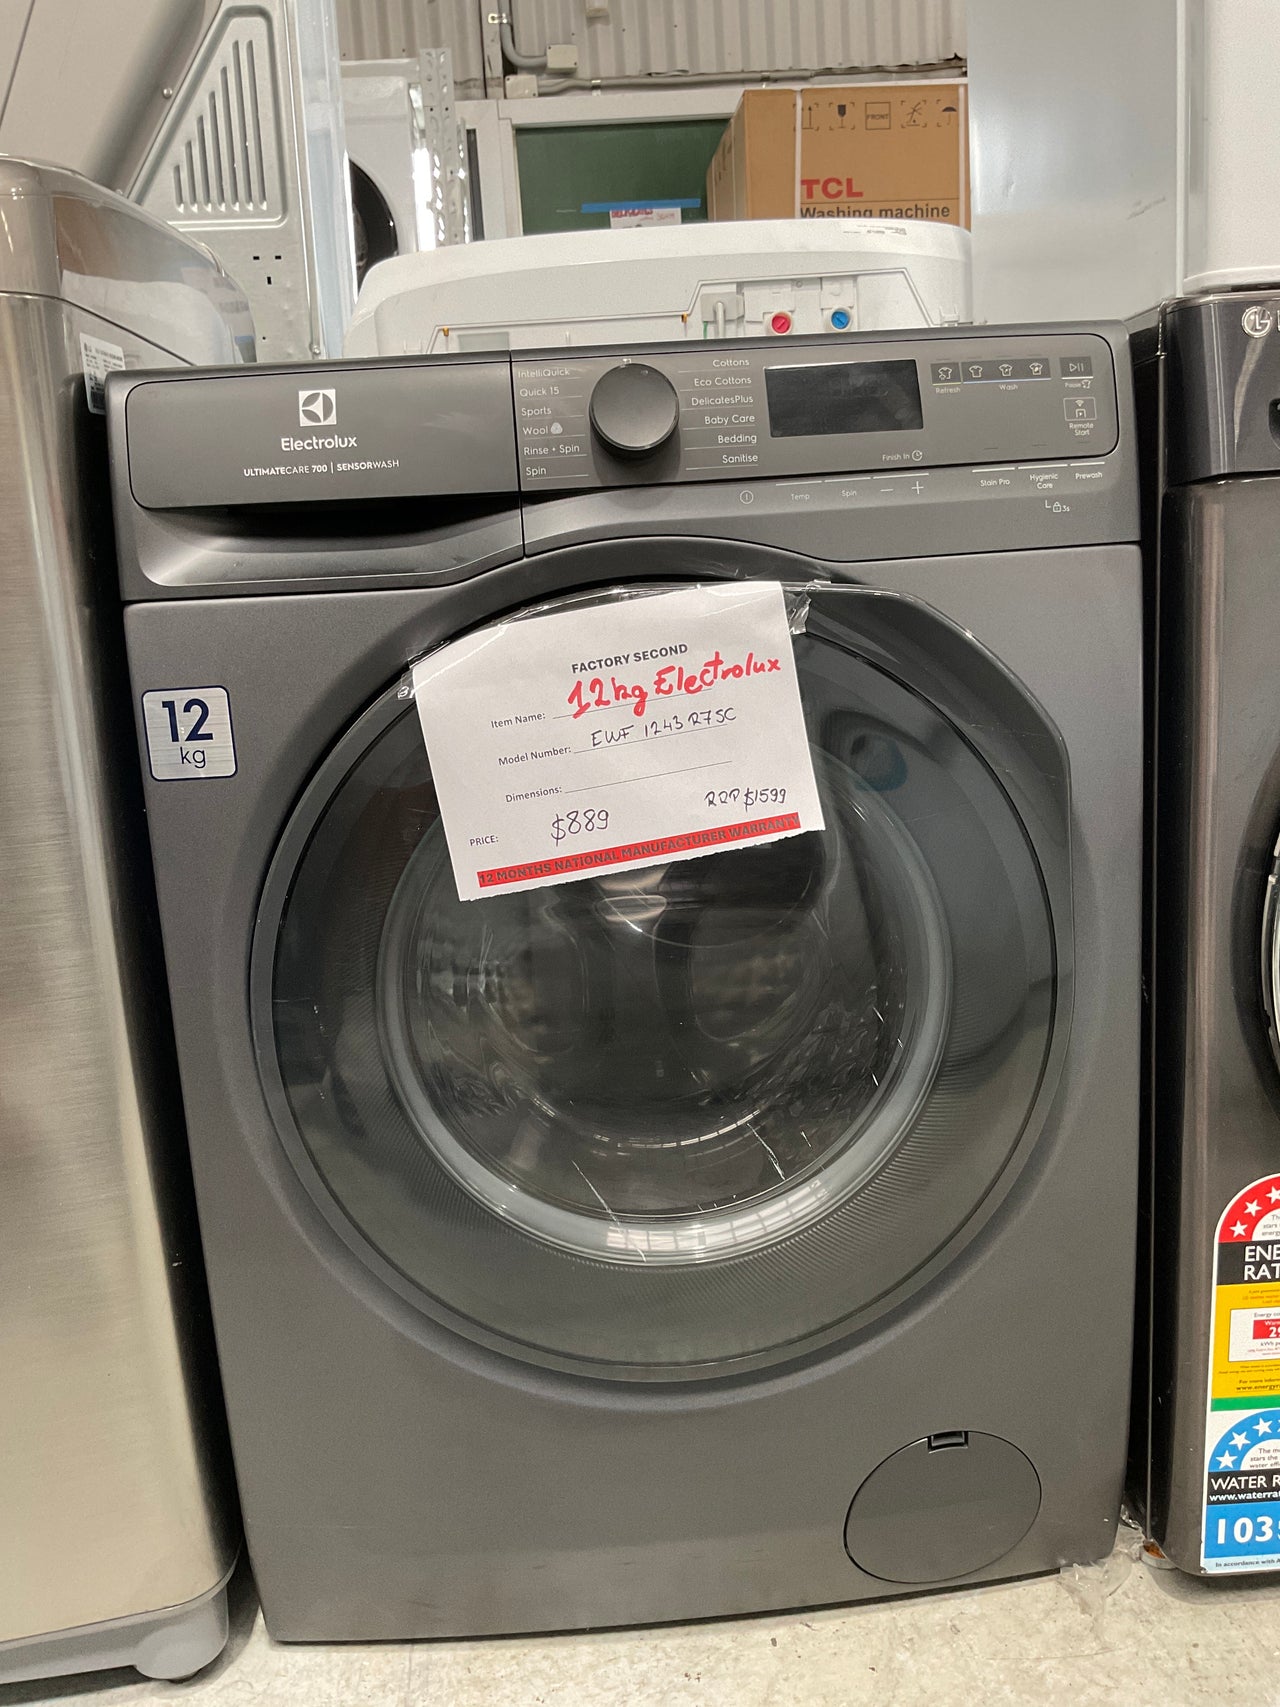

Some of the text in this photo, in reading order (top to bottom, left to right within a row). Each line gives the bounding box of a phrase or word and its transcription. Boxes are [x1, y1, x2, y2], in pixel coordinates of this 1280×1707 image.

[801, 177, 864, 199] TCL
[800, 203, 950, 218] Washing machine
[713, 359, 750, 367] Cottons
[518, 368, 570, 378] IntelliQuick
[694, 377, 752, 387] Eco Cottons
[520, 386, 560, 397] Quick 15
[691, 395, 754, 406] DelicatesPlus
[521, 406, 552, 417] Sports
[704, 414, 755, 426] Baby Care
[522, 426, 549, 436] Wool
[281, 434, 358, 451] Electrolux
[718, 434, 757, 444] Bedding
[523, 447, 549, 456] Rinse
[559, 444, 580, 455] Spin
[722, 453, 758, 463] Sanitise
[882, 453, 901, 461] Finish
[243, 460, 400, 477] ULTIMATECARE 700 SENSORWASH
[525, 467, 547, 477] Spin
[1029, 472, 1058, 482] Hygienic
[1075, 472, 1103, 480] Prewash
[1037, 482, 1053, 490] Care
[791, 489, 857, 501] Temp Spin
[571, 643, 688, 674] FACTORY SECOND
[491, 718, 513, 729] Item
[514, 712, 546, 725] Name:
[653, 651, 782, 695] Electrolux
[161, 698, 214, 742] 12
[498, 752, 529, 766] Model
[530, 746, 572, 760] Number:
[591, 724, 635, 747] EWF
[644, 715, 684, 738] 1243
[180, 746, 206, 769] kg
[505, 786, 563, 803] Dimensions:
[743, 787, 787, 813] $1599
[469, 808, 609, 847] PRICE: $889
[479, 814, 800, 884] 12 MONTHS NATIONAL MANUFACTURER WARRANTY
[1210, 1475, 1268, 1490] WATER
